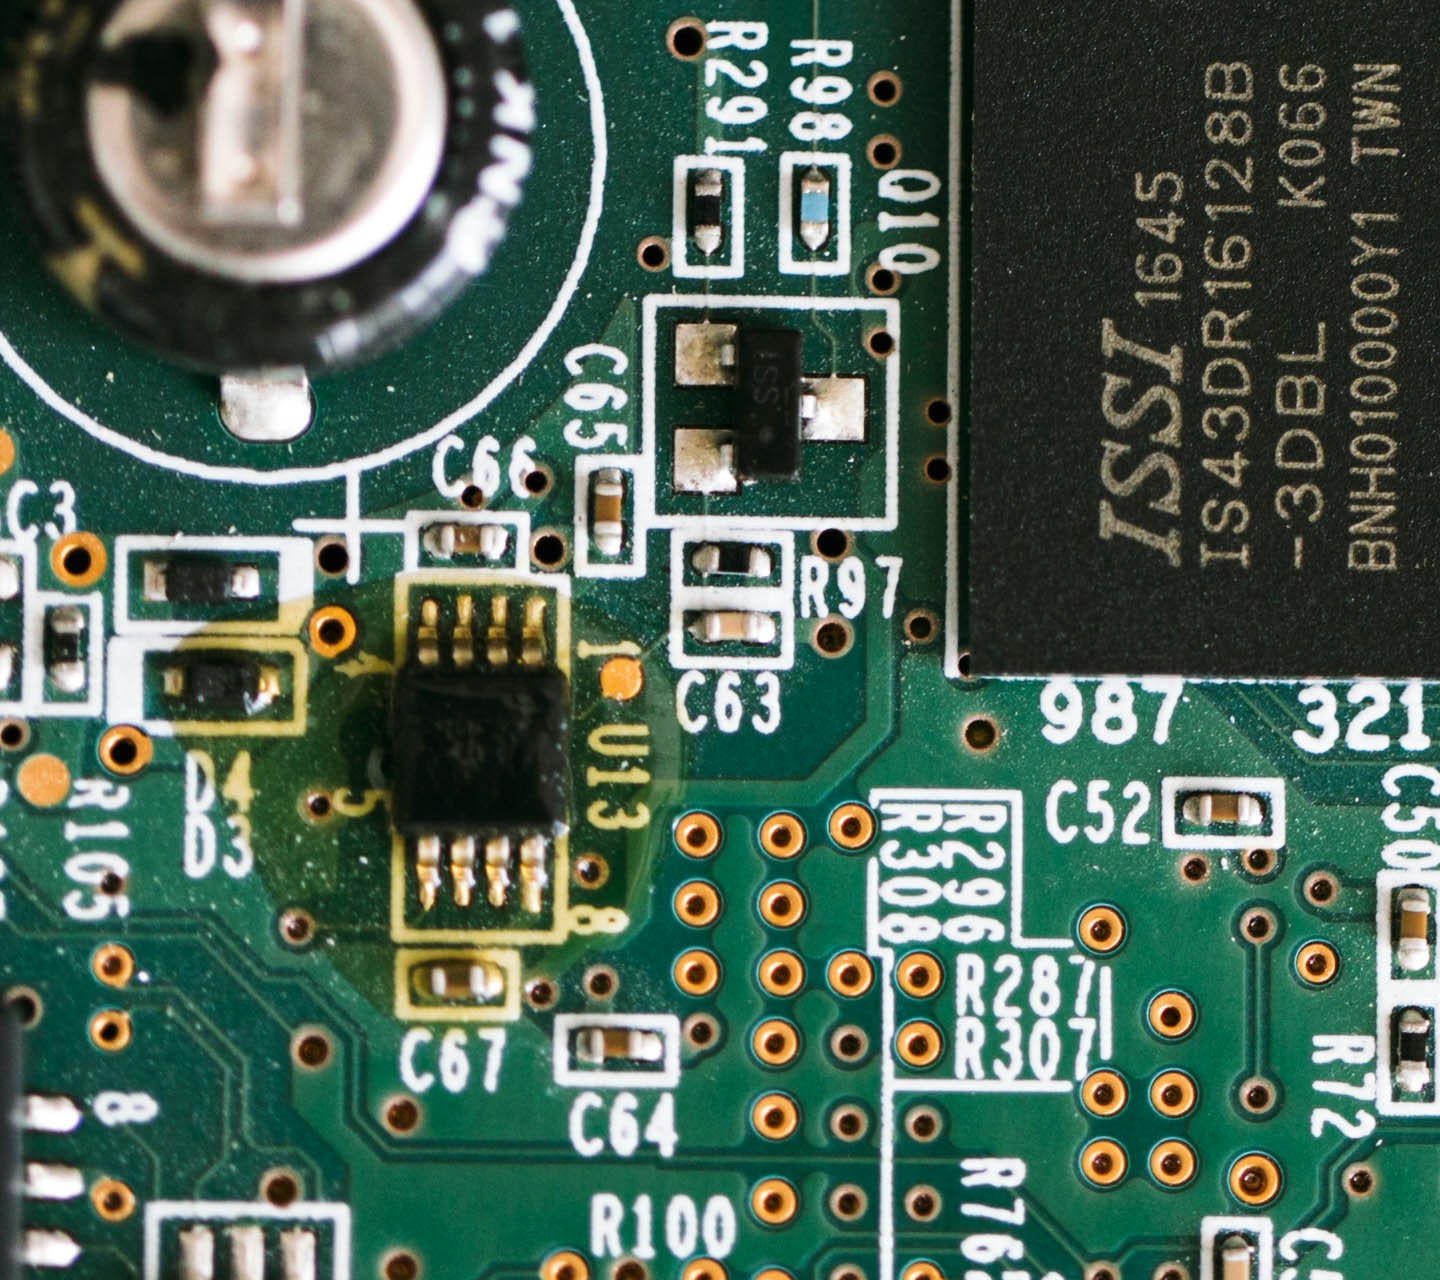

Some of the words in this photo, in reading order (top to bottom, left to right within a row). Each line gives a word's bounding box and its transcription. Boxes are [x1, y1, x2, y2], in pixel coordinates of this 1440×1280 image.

[704, 20, 768, 154] R291
[790, 40, 852, 140] R98
[1279, 64, 1327, 209] K066
[1353, 64, 1401, 164] TWN
[879, 170, 942, 275] Q10
[1136, 172, 1184, 309] 1645
[1200, 61, 1255, 568] IS43DR16128B
[564, 344, 628, 448] C65
[1100, 318, 1184, 567] ISSI
[1276, 322, 1327, 568] -3DBL
[802, 555, 902, 619] R97
[677, 671, 781, 734] C63
[1038, 676, 1183, 745] 987
[1293, 683, 1428, 751] 321
[588, 723, 649, 829] U13
[1046, 779, 1151, 844] C52
[879, 805, 942, 945] R308
[940, 803, 1004, 942] R296
[956, 955, 1094, 1017] R287
[401, 1029, 505, 1092] C67
[954, 1018, 1095, 1080] R307
[1311, 1035, 1377, 1137] R72
[568, 1093, 678, 1156] C64
[591, 1194, 737, 1258] R100
[960, 1156, 1026, 1262] R76
